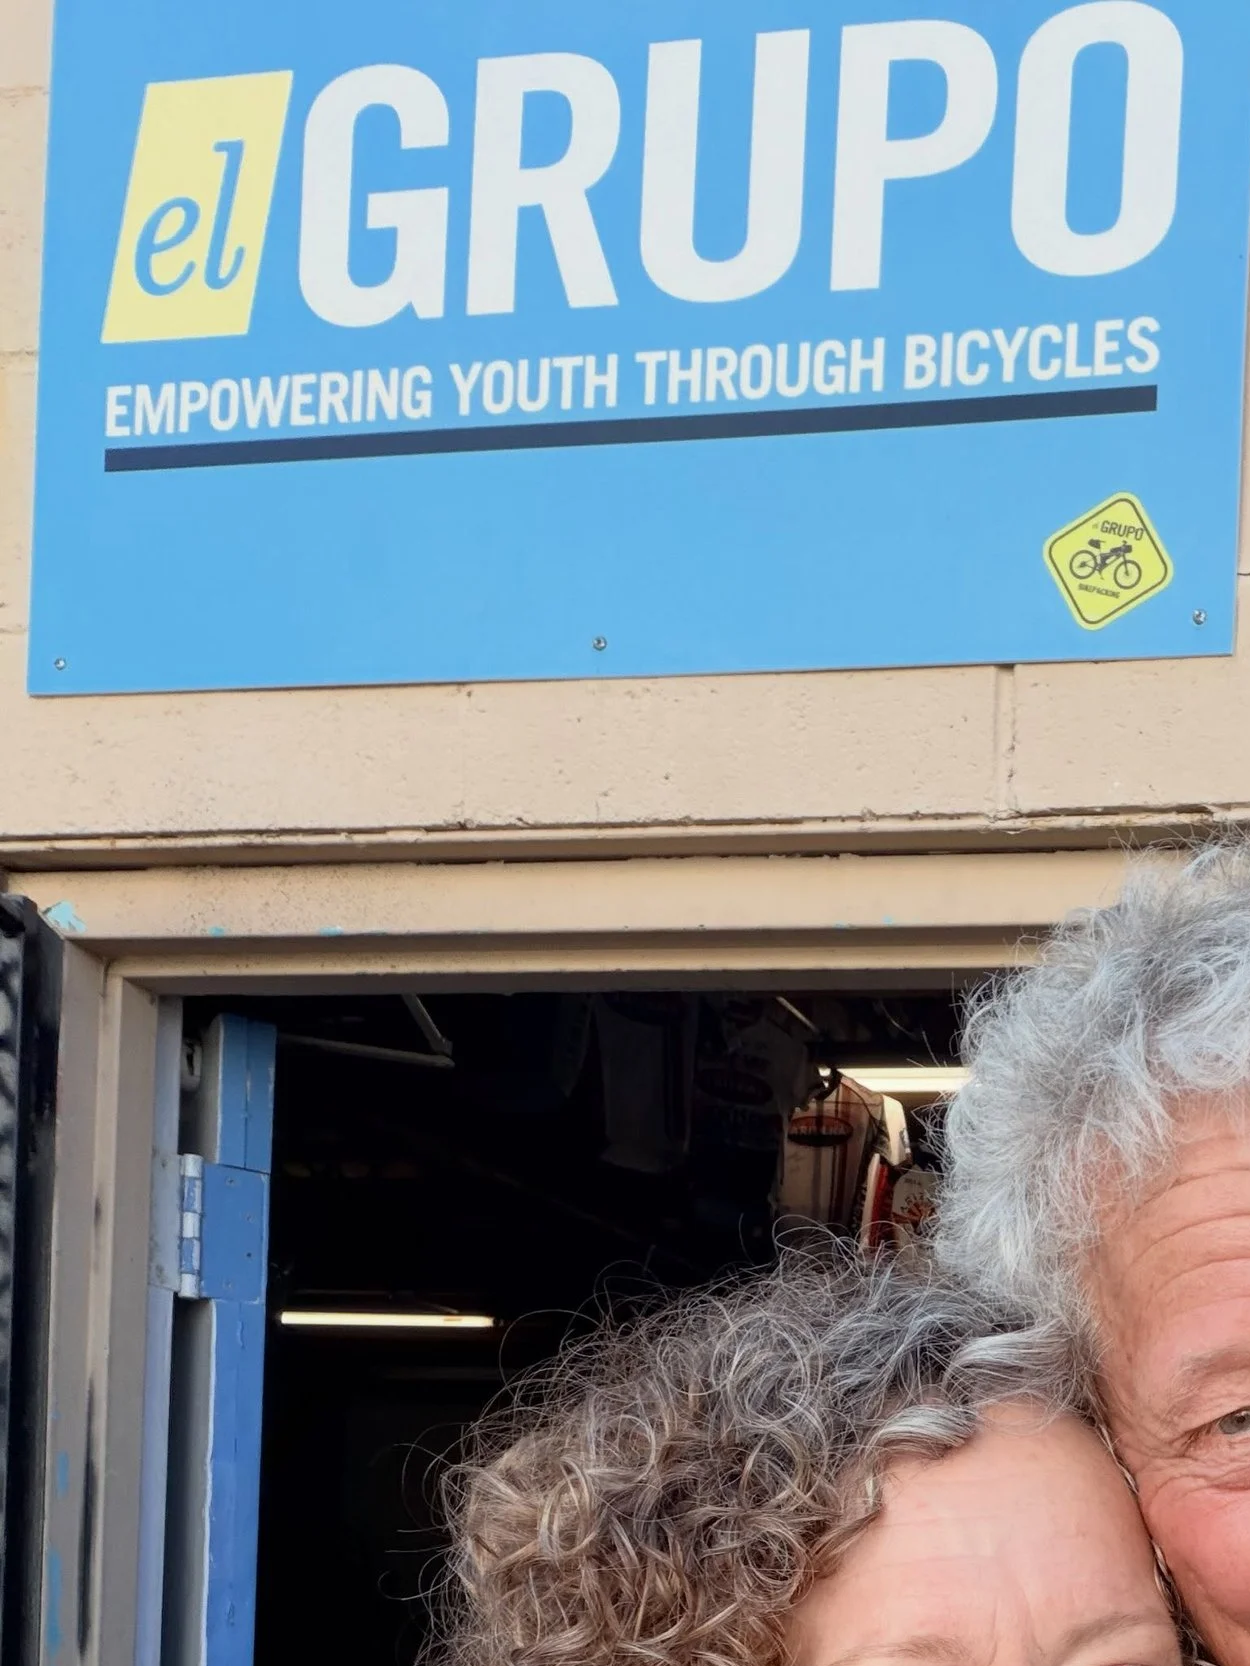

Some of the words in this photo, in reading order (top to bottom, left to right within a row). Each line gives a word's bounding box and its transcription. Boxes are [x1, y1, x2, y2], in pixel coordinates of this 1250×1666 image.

[134, 138, 246, 297] el
[298, 0, 1184, 328] GRUPO
[105, 365, 432, 437] EMPOWERING
[449, 353, 618, 416] YOUTH
[635, 336, 886, 404] THROUGH
[903, 315, 1160, 390] BICYCLES
[1100, 520, 1144, 541] GRUPO
